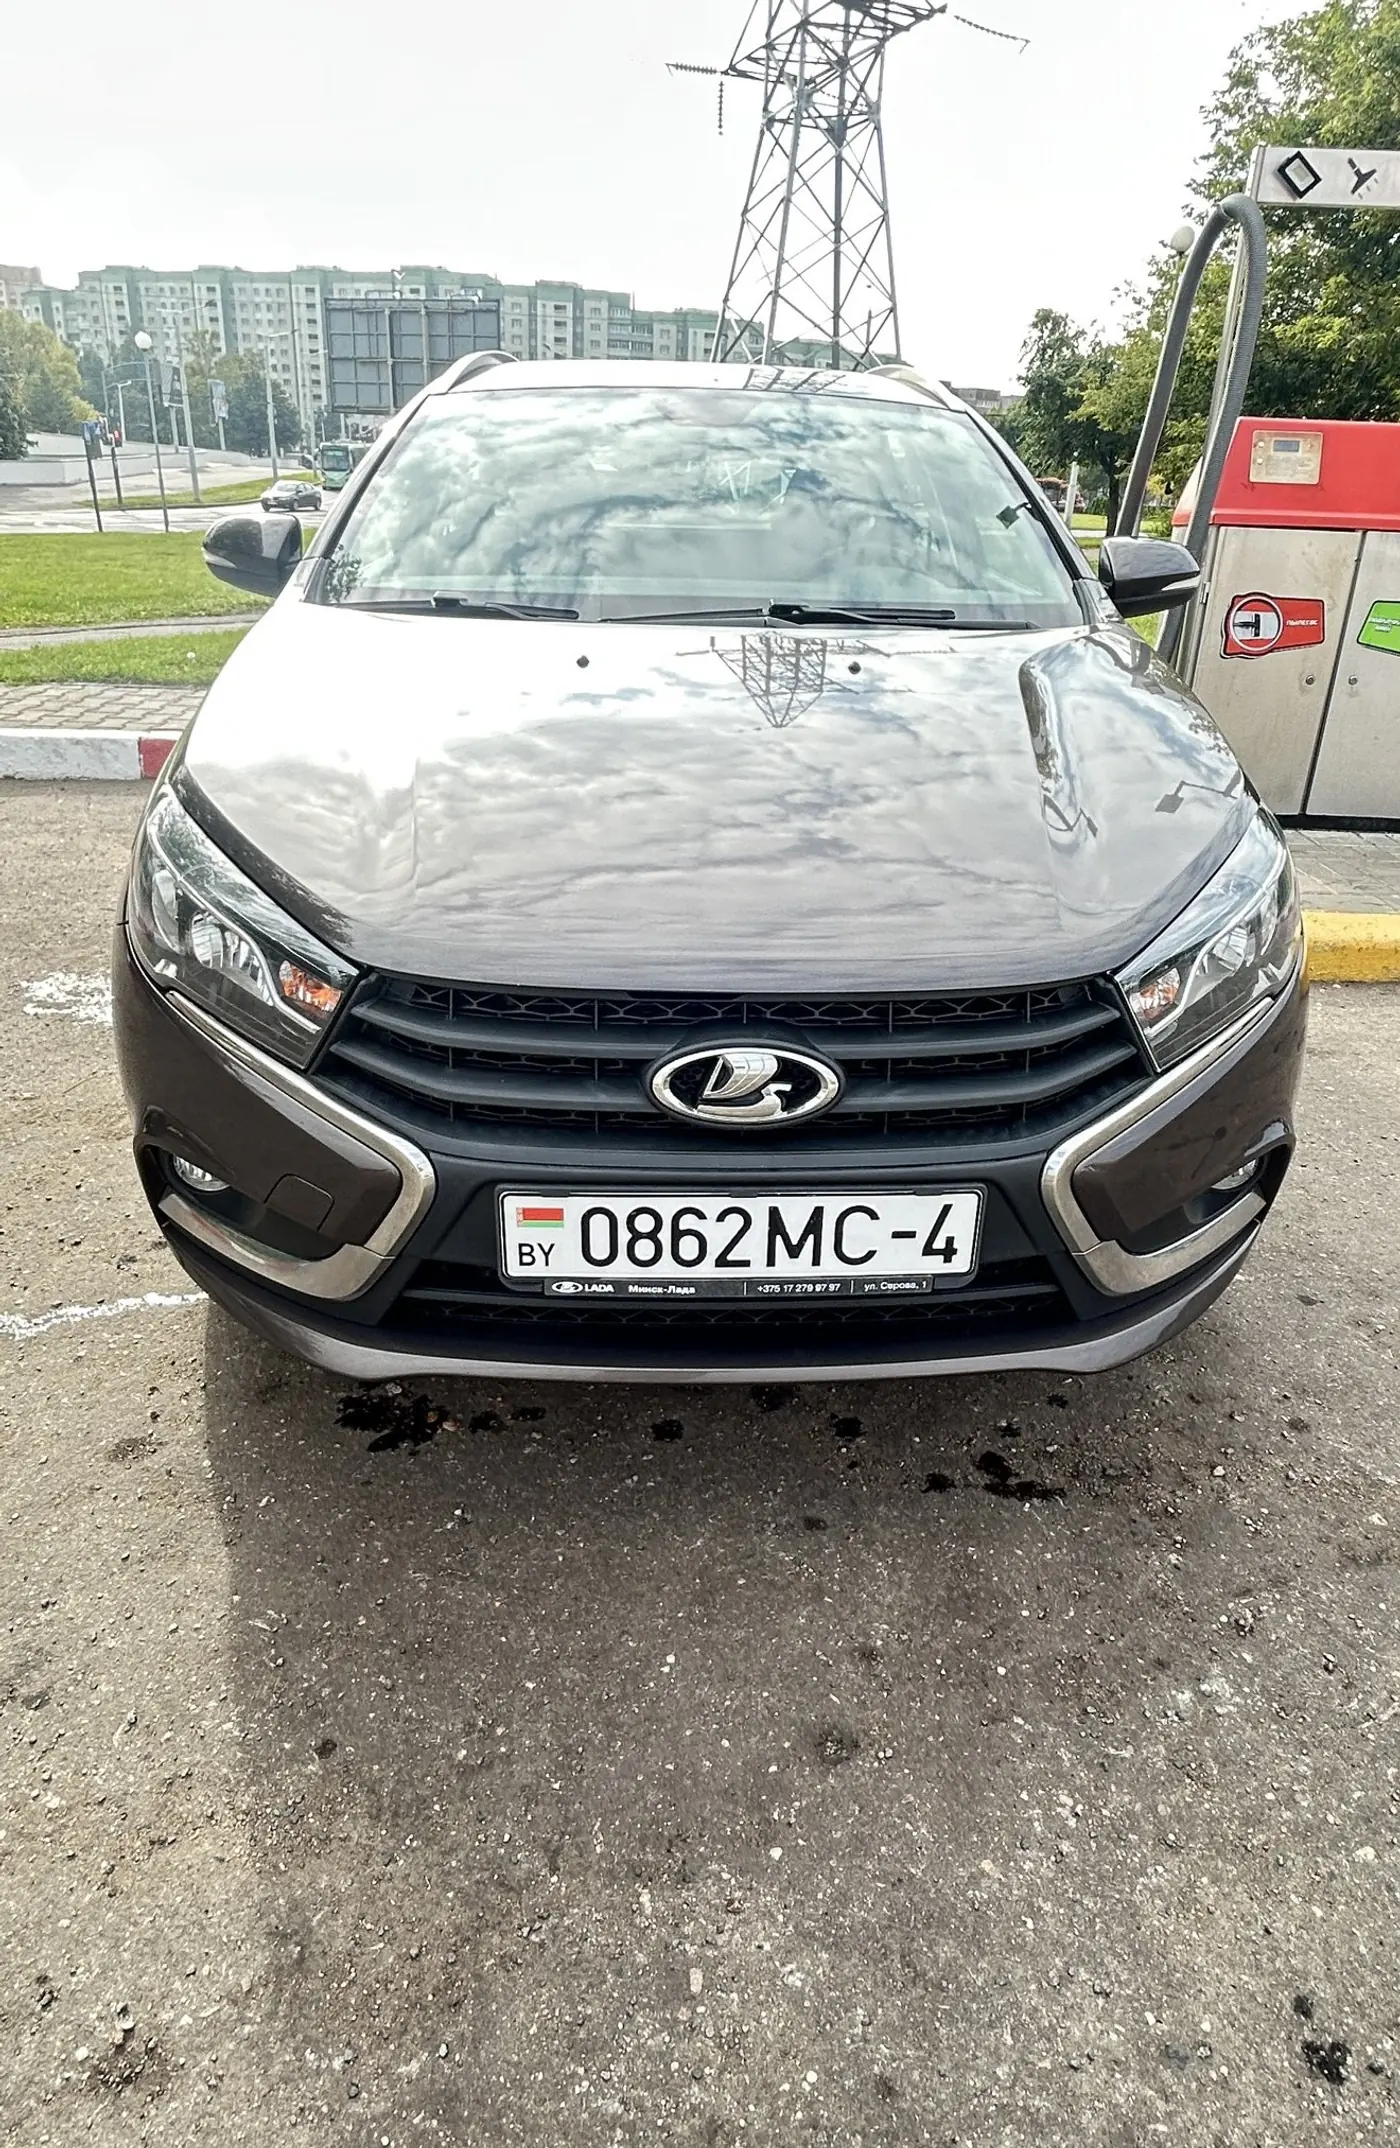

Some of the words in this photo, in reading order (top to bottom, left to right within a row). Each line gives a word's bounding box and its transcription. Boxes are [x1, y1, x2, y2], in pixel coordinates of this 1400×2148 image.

[518, 1242, 555, 1267] BY
[584, 1284, 615, 1293] LADA
[628, 1284, 697, 1295] Минск-Лада
[757, 1284, 781, 1293] +375
[783, 1284, 794, 1292] 17
[864, 1283, 879, 1292] ул.
